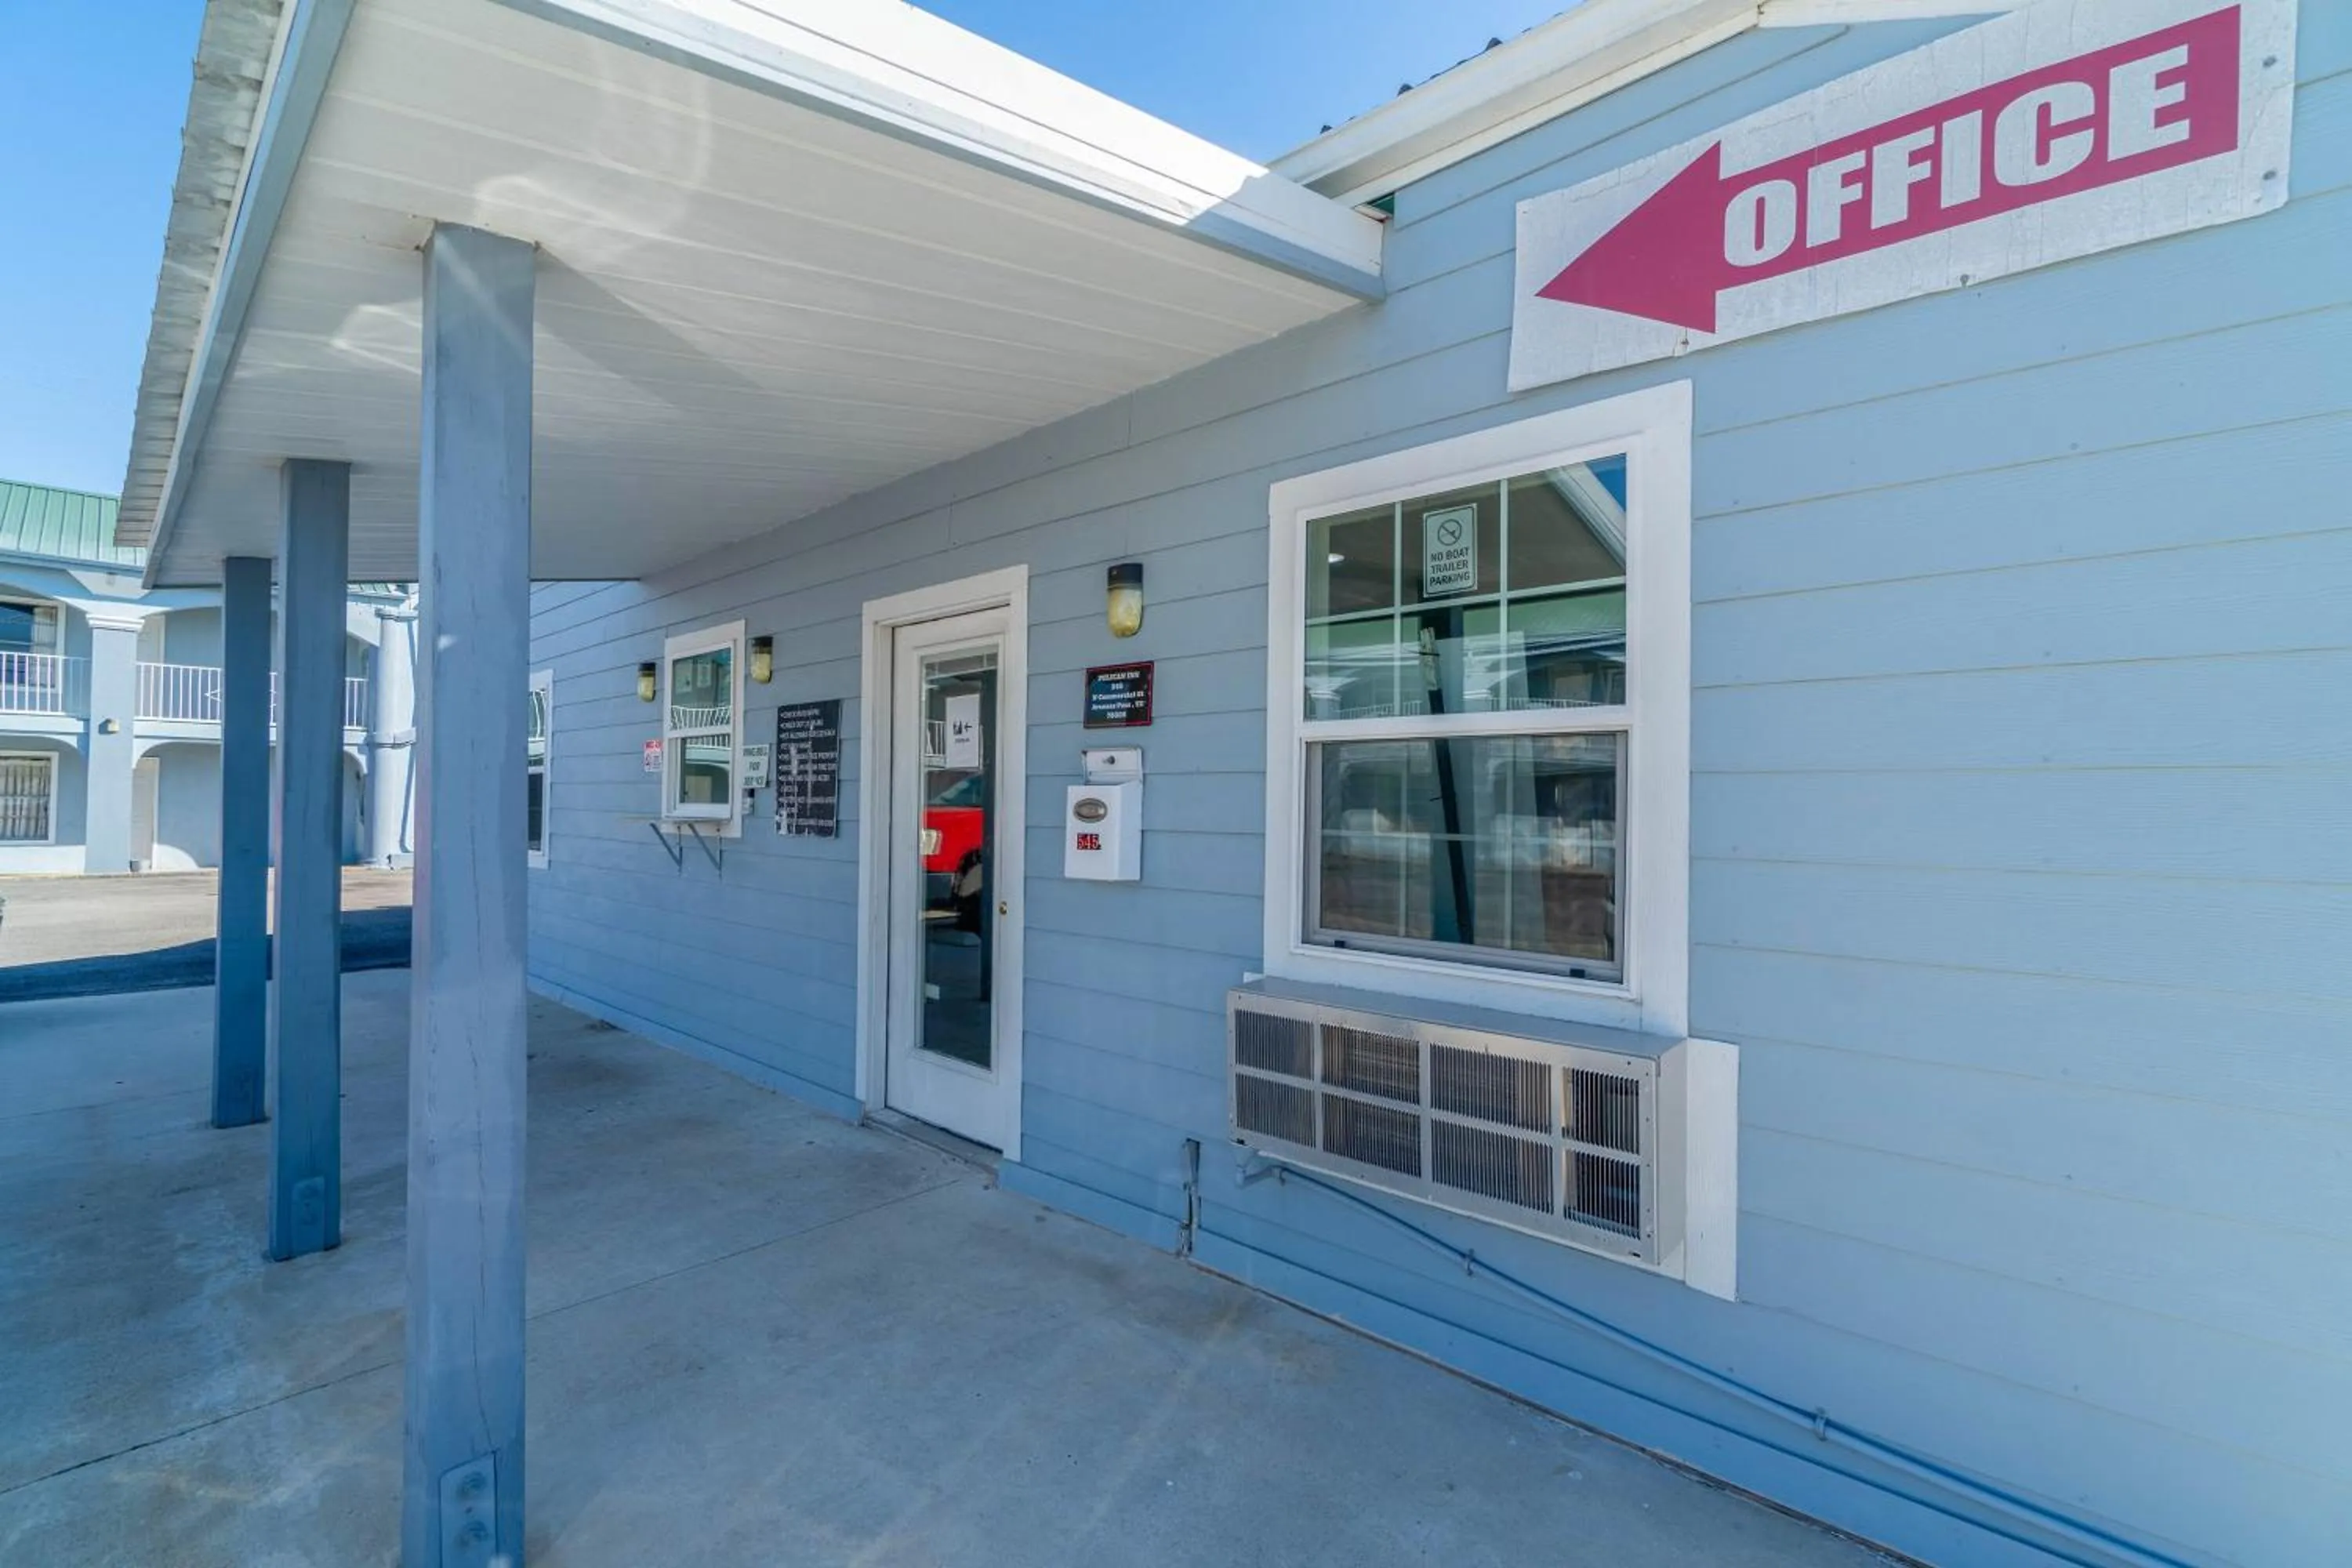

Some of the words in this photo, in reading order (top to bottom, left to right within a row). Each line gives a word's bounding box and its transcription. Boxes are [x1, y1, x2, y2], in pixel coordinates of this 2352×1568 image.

[1724, 43, 2189, 267] OFFICE
[1431, 551, 1443, 561] NO
[1446, 546, 1468, 560] BOAT
[1431, 560, 1468, 574] TRAILER
[1429, 571, 1470, 586] PARKING
[1079, 834, 1098, 849] 545
